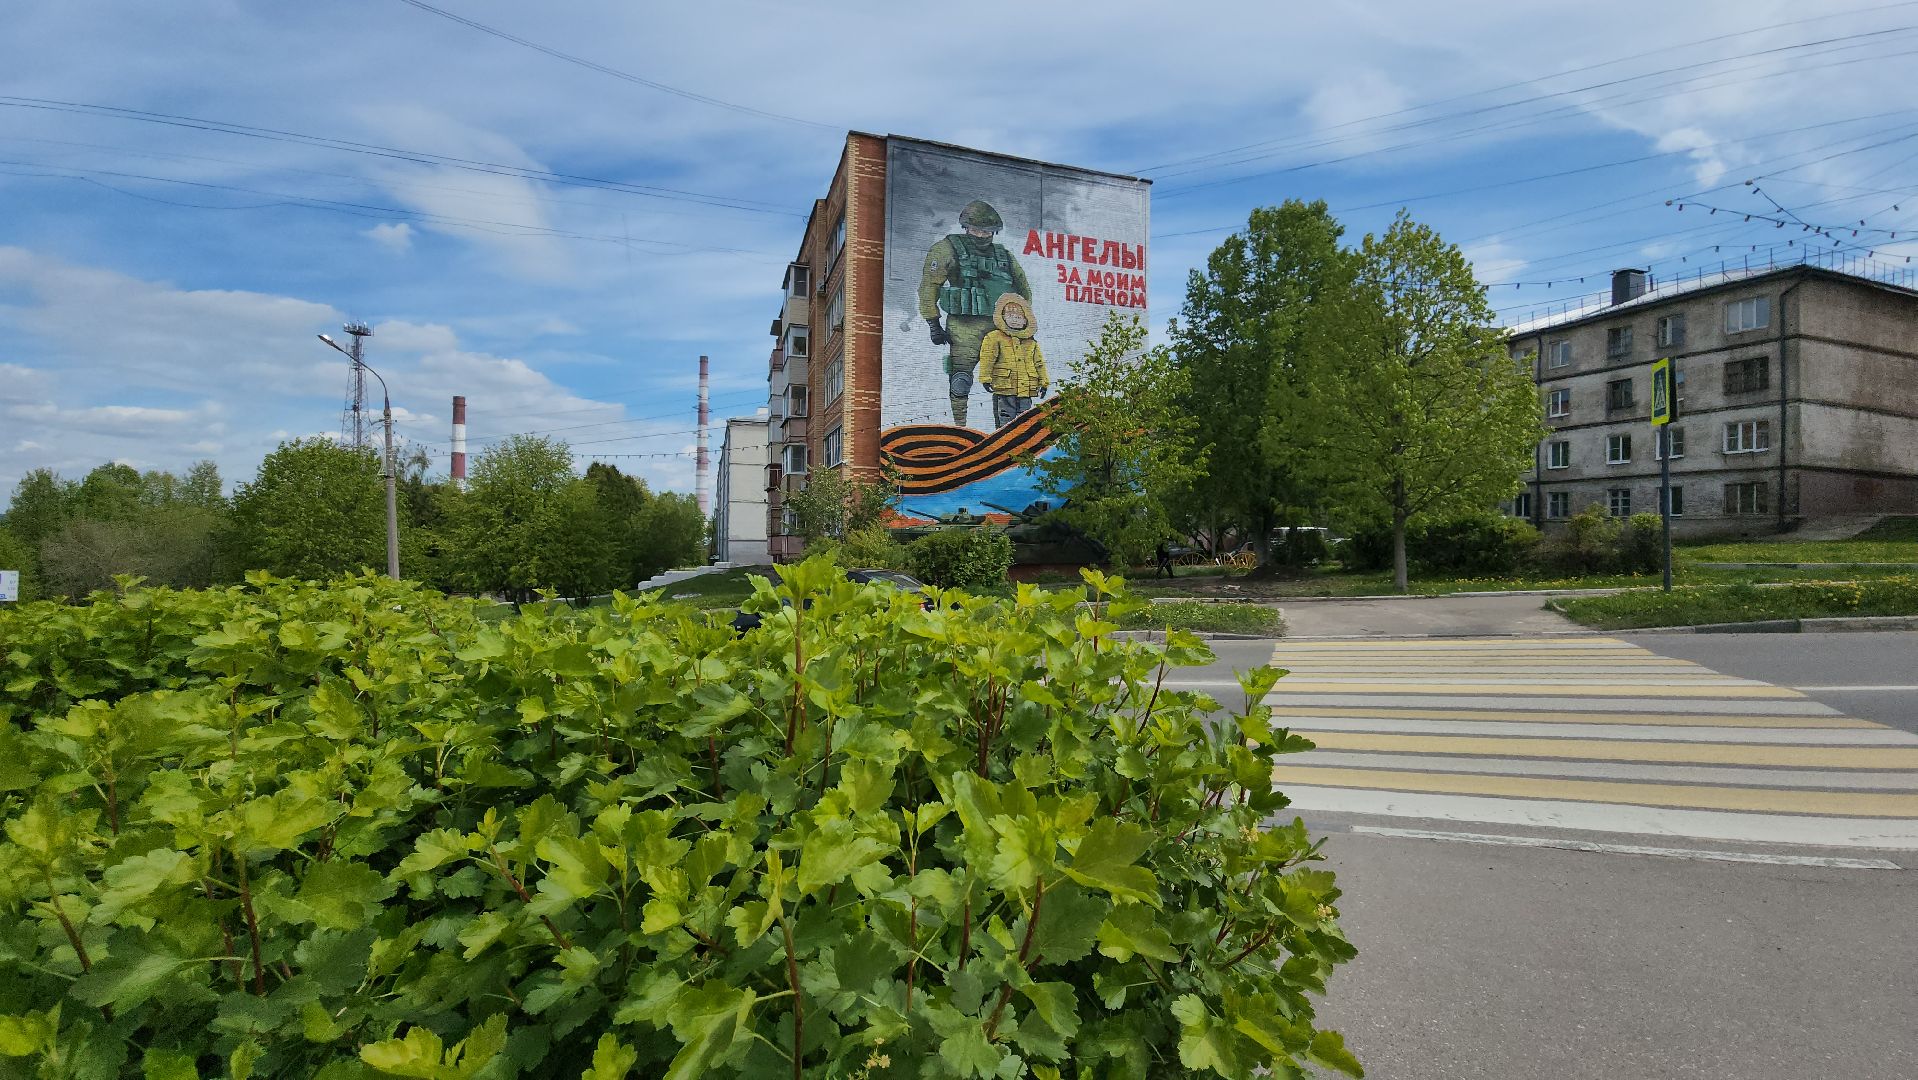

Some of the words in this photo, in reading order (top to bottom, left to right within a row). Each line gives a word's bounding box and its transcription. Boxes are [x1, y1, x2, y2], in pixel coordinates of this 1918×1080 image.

[1023, 229, 1144, 271] АНГЕЛЫ
[1056, 263, 1083, 285] ЗА
[1087, 269, 1146, 293] МОИМ
[1065, 284, 1147, 309] ПЛЕЧОМ
